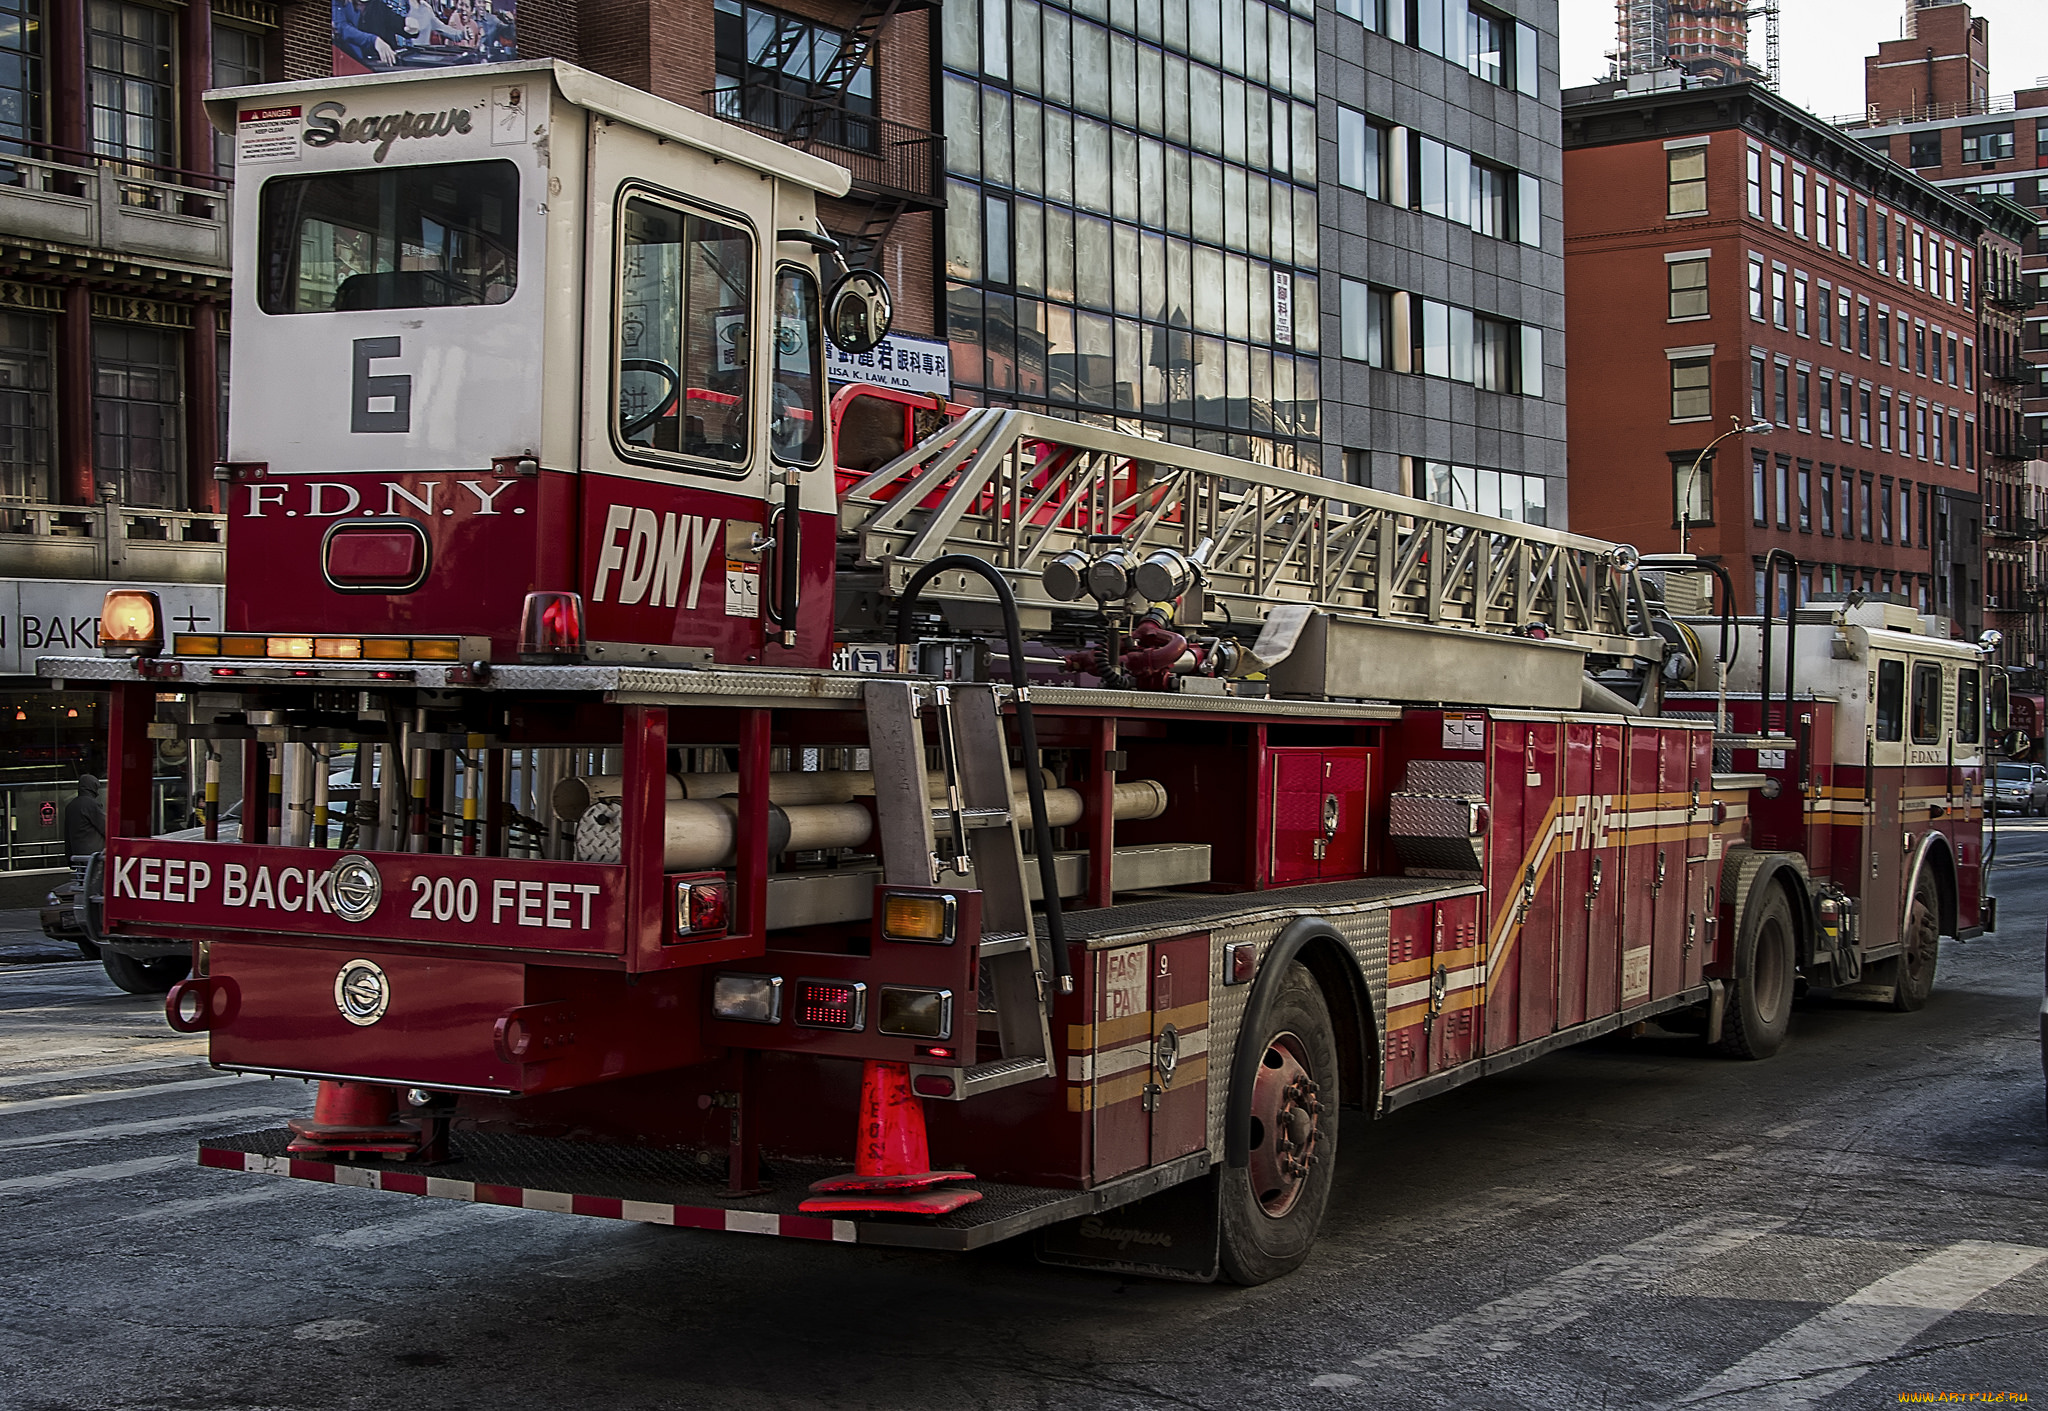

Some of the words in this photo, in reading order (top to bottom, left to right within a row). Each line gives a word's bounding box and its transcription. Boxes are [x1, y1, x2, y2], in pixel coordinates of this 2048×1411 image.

[262, 109, 292, 118] DANGER
[303, 101, 473, 163] Seagrave
[351, 336, 411, 433] 6
[828, 366, 849, 378] LISA
[853, 370, 863, 379] K.
[866, 372, 887, 385] LAW,
[891, 376, 912, 387] M.D.
[243, 480, 526, 517] F.D.N.Y.
[592, 504, 722, 609] FDNY
[1325, 762, 1332, 778] 7
[1911, 750, 1945, 764] F.D.N.Y.
[1571, 795, 1612, 851] FIRE
[113, 856, 211, 903] KEEP
[223, 863, 333, 914] BACK
[410, 875, 479, 923] 200
[492, 879, 600, 930] FEET
[1109, 951, 1146, 983] FAST
[1160, 954, 1169, 975] 9
